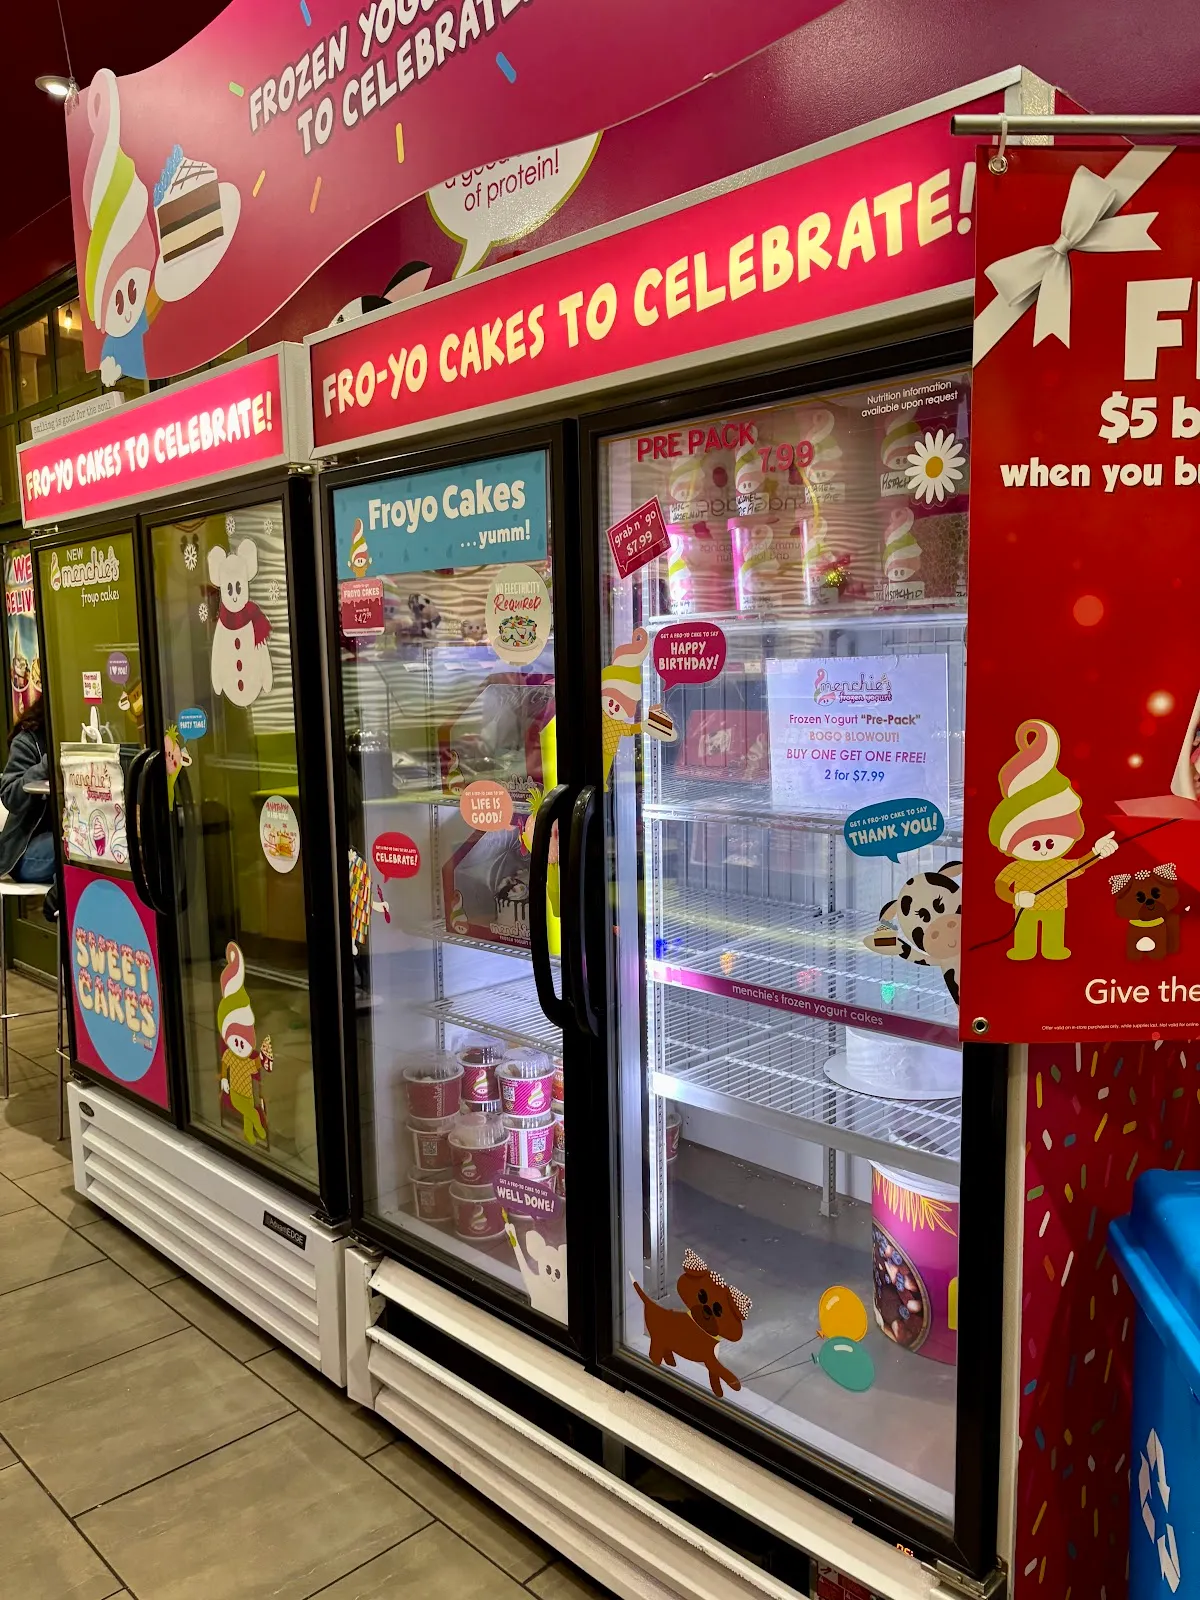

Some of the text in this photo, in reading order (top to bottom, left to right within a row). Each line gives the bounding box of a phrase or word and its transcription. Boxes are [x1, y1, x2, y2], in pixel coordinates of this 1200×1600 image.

[250, 26, 347, 132] FROZEN
[297, 98, 333, 154] TO
[464, 182, 482, 211] of
[487, 148, 559, 208] protein!
[322, 161, 976, 418] FRO-YO CAKES TO CELEBRATE!
[1123, 277, 1200, 381] F
[861, 390, 959, 417] available upon request
[867, 381, 952, 404] Nutrition information
[56, 418, 61, 428] is
[62, 412, 76, 426] good
[76, 409, 86, 420] for
[86, 405, 97, 416] the
[97, 400, 111, 413] soul
[1098, 390, 1157, 444] $5
[25, 391, 272, 501] FRO-YO CAKES TO CELEBRATE!
[637, 420, 756, 463] PRE PACK
[757, 440, 815, 473] 7.99
[1000, 456, 1091, 488] when
[1102, 463, 1163, 493] you
[368, 478, 526, 533] Froyo Cakes
[615, 524, 633, 548] grab
[645, 510, 657, 527] go
[66, 547, 83, 561] NEW
[626, 531, 653, 556] $7.99
[13, 553, 33, 584] WE
[62, 545, 120, 588] menchie's
[6, 587, 35, 616] DELIV
[81, 585, 119, 608] froyo cakes
[344, 587, 380, 598] FROYO CAKES
[504, 581, 540, 595] ELECTRICITY
[658, 653, 720, 670] BIRTHDAY!
[670, 641, 706, 655] HAPPY
[820, 672, 892, 692] menchie's
[839, 691, 893, 703] frozen yogurt
[789, 714, 822, 724] Frozen
[824, 714, 858, 727] Yogurt
[809, 731, 900, 743] BOGO BLOWOUT!
[786, 748, 926, 764] BUY ONE GET ONE FREE!
[824, 769, 885, 783] 2 for $7.99
[471, 797, 501, 810] LIFE IS
[471, 811, 502, 824] GOOD!
[849, 805, 928, 828] GET A FRO-YO CAKE TO SAY
[848, 811, 938, 847] THANK YOU!
[376, 852, 418, 867] CELEBRATE!
[75, 927, 151, 992] SWEET
[77, 968, 156, 1038] CAKES
[732, 984, 883, 1026] menchie's frozen yogurt cakes
[1085, 978, 1150, 1005] Give
[496, 1185, 555, 1213] WELL DONE!
